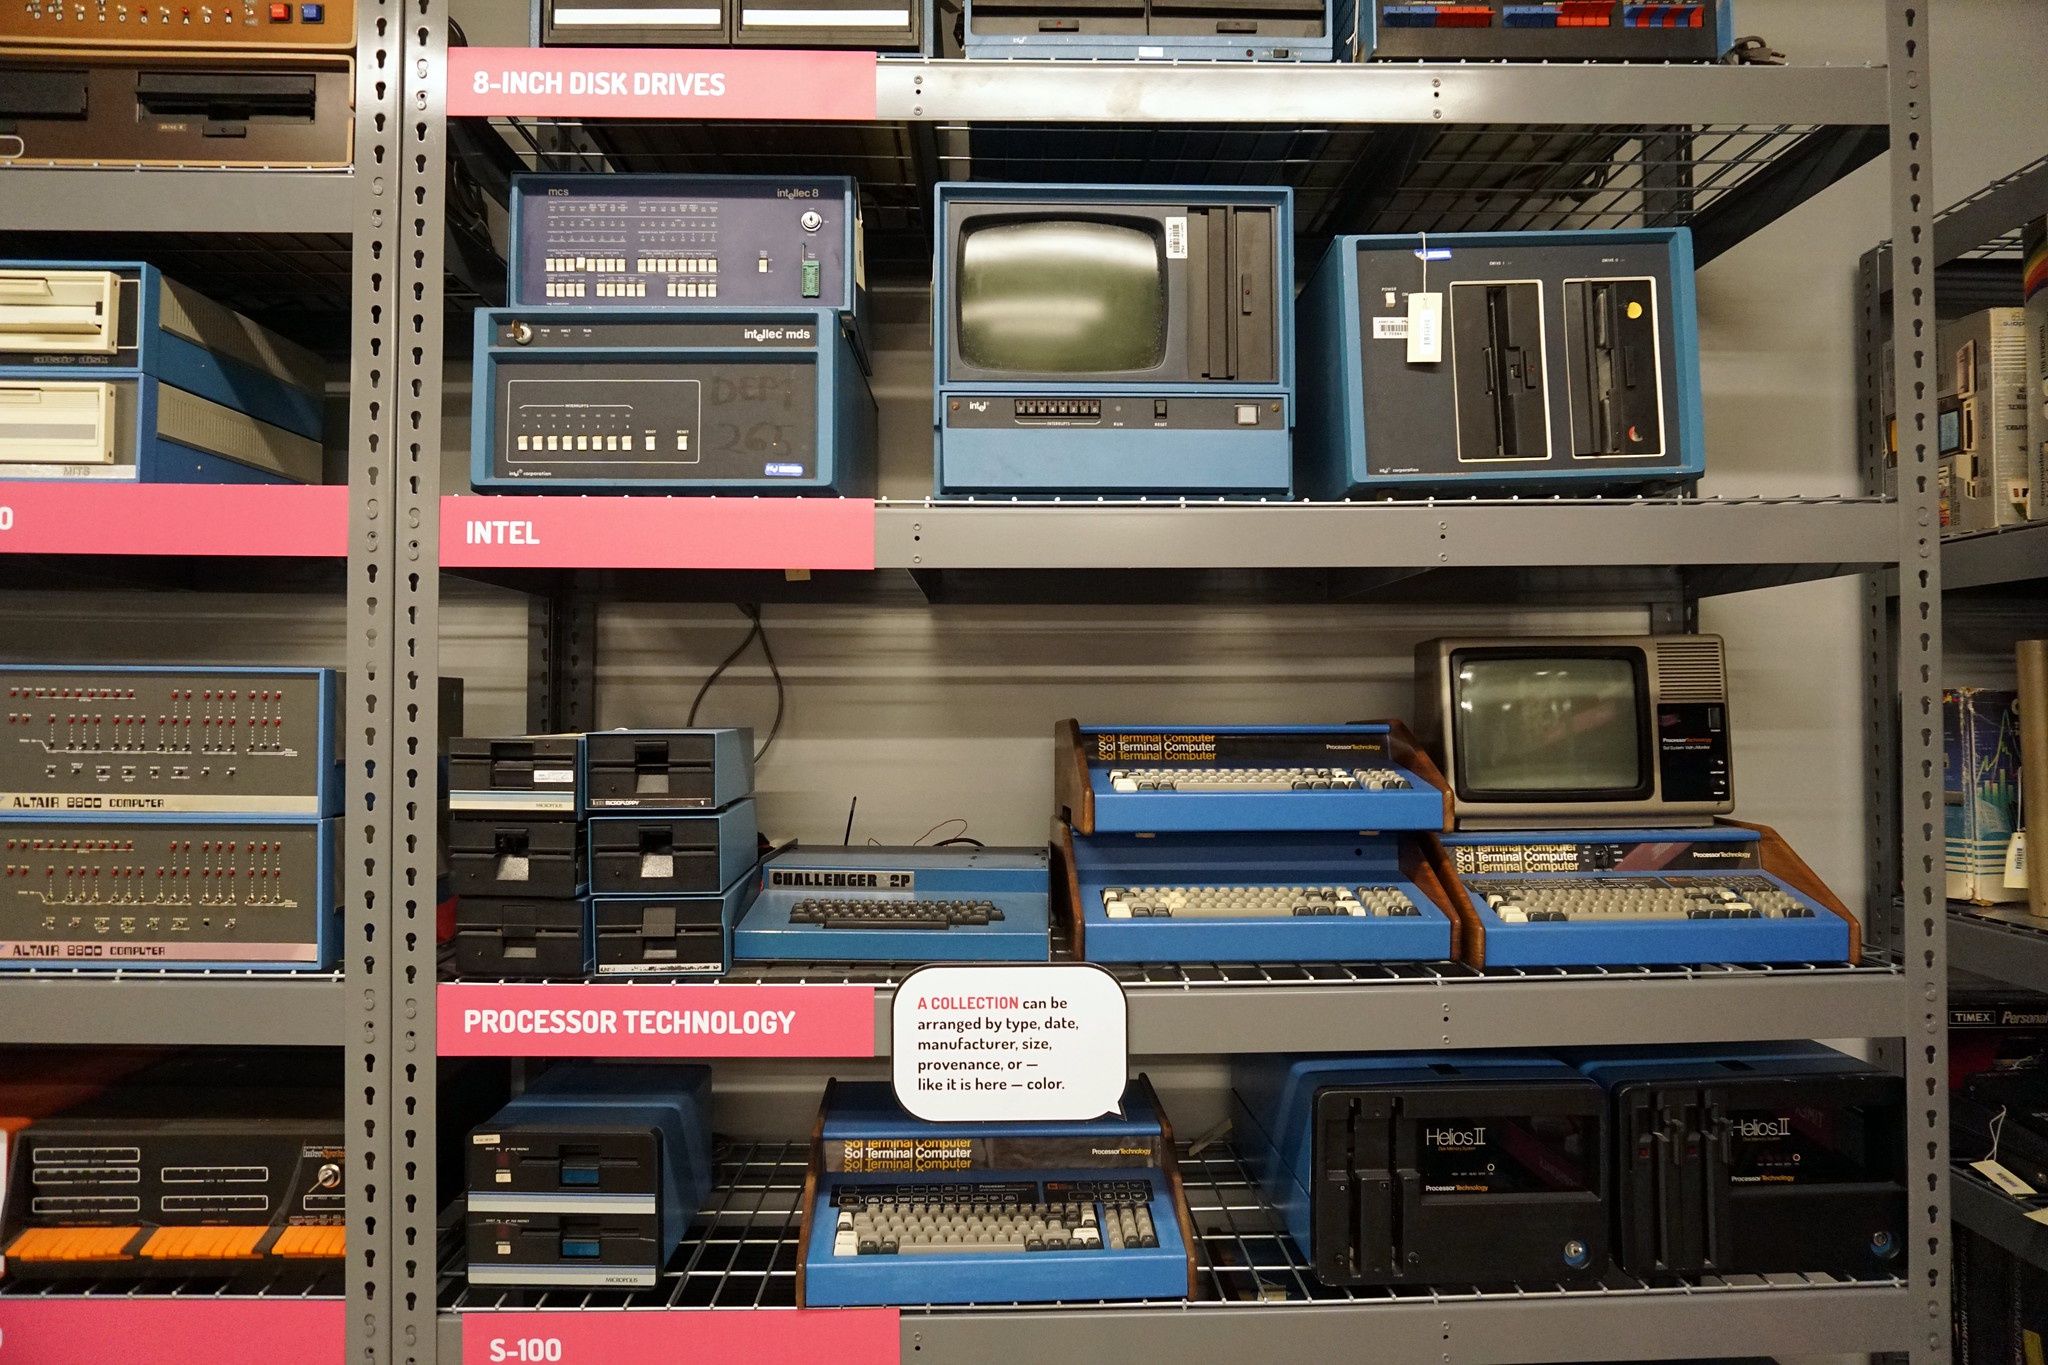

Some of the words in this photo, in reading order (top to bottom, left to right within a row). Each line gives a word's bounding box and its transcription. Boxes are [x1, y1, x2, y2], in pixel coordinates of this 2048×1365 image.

[473, 71, 562, 94] 8-INCH
[570, 72, 627, 95] DISK
[633, 72, 726, 96] DRIVES
[548, 188, 569, 196] mcs
[786, 328, 811, 339] mds
[466, 520, 540, 545] INTEL
[1098, 742, 1116, 751] Sol
[1118, 741, 1162, 751] Terminal
[1164, 742, 1216, 752] Computer
[13, 797, 59, 808] ALTAIR
[67, 797, 102, 808] 8800
[109, 799, 165, 808] COMPUTER
[1456, 852, 1474, 862] Sol
[1476, 852, 1522, 862] Terminal
[1524, 852, 1578, 863] Computer
[1457, 861, 1474, 871] Sol
[1477, 861, 1523, 871] Terminal
[1525, 861, 1579, 872] Computer
[773, 872, 877, 887] CHALLENGER
[890, 874, 911, 887] 2P
[13, 944, 59, 956] ALTAIR
[67, 945, 102, 956] 8800
[110, 946, 165, 956] COMPUTER
[917, 997, 928, 1010] A
[931, 997, 1019, 1010] COLLECTION
[1022, 999, 1047, 1009] can
[1051, 997, 1068, 1009] be
[464, 1009, 618, 1034] PROCESSOR
[623, 1010, 796, 1035] TECHNOLOGY
[1955, 1013, 1991, 1022] TIMEX
[918, 1017, 981, 1033] arranged
[985, 1017, 1002, 1033] by
[1006, 1017, 1041, 1033] type,
[1044, 1017, 1079, 1030] date,
[918, 1037, 1019, 1051] manufacturer,
[1022, 1037, 1052, 1051] size,
[918, 1060, 1004, 1074] provenance,
[1007, 1061, 1022, 1070] or
[918, 1078, 943, 1090] like
[947, 1078, 957, 1090] it
[960, 1078, 971, 1090] is
[975, 1078, 1008, 1090] here
[1027, 1077, 1065, 1090] color.
[844, 1148, 863, 1159] Sol
[865, 1147, 913, 1159] Terminal
[915, 1147, 971, 1160] Computer
[844, 1159, 863, 1169] Sol
[866, 1159, 913, 1169] Terminal
[915, 1159, 971, 1170] Computer
[1456, 1184, 1489, 1192] Technology
[489, 1338, 562, 1362] S-100
